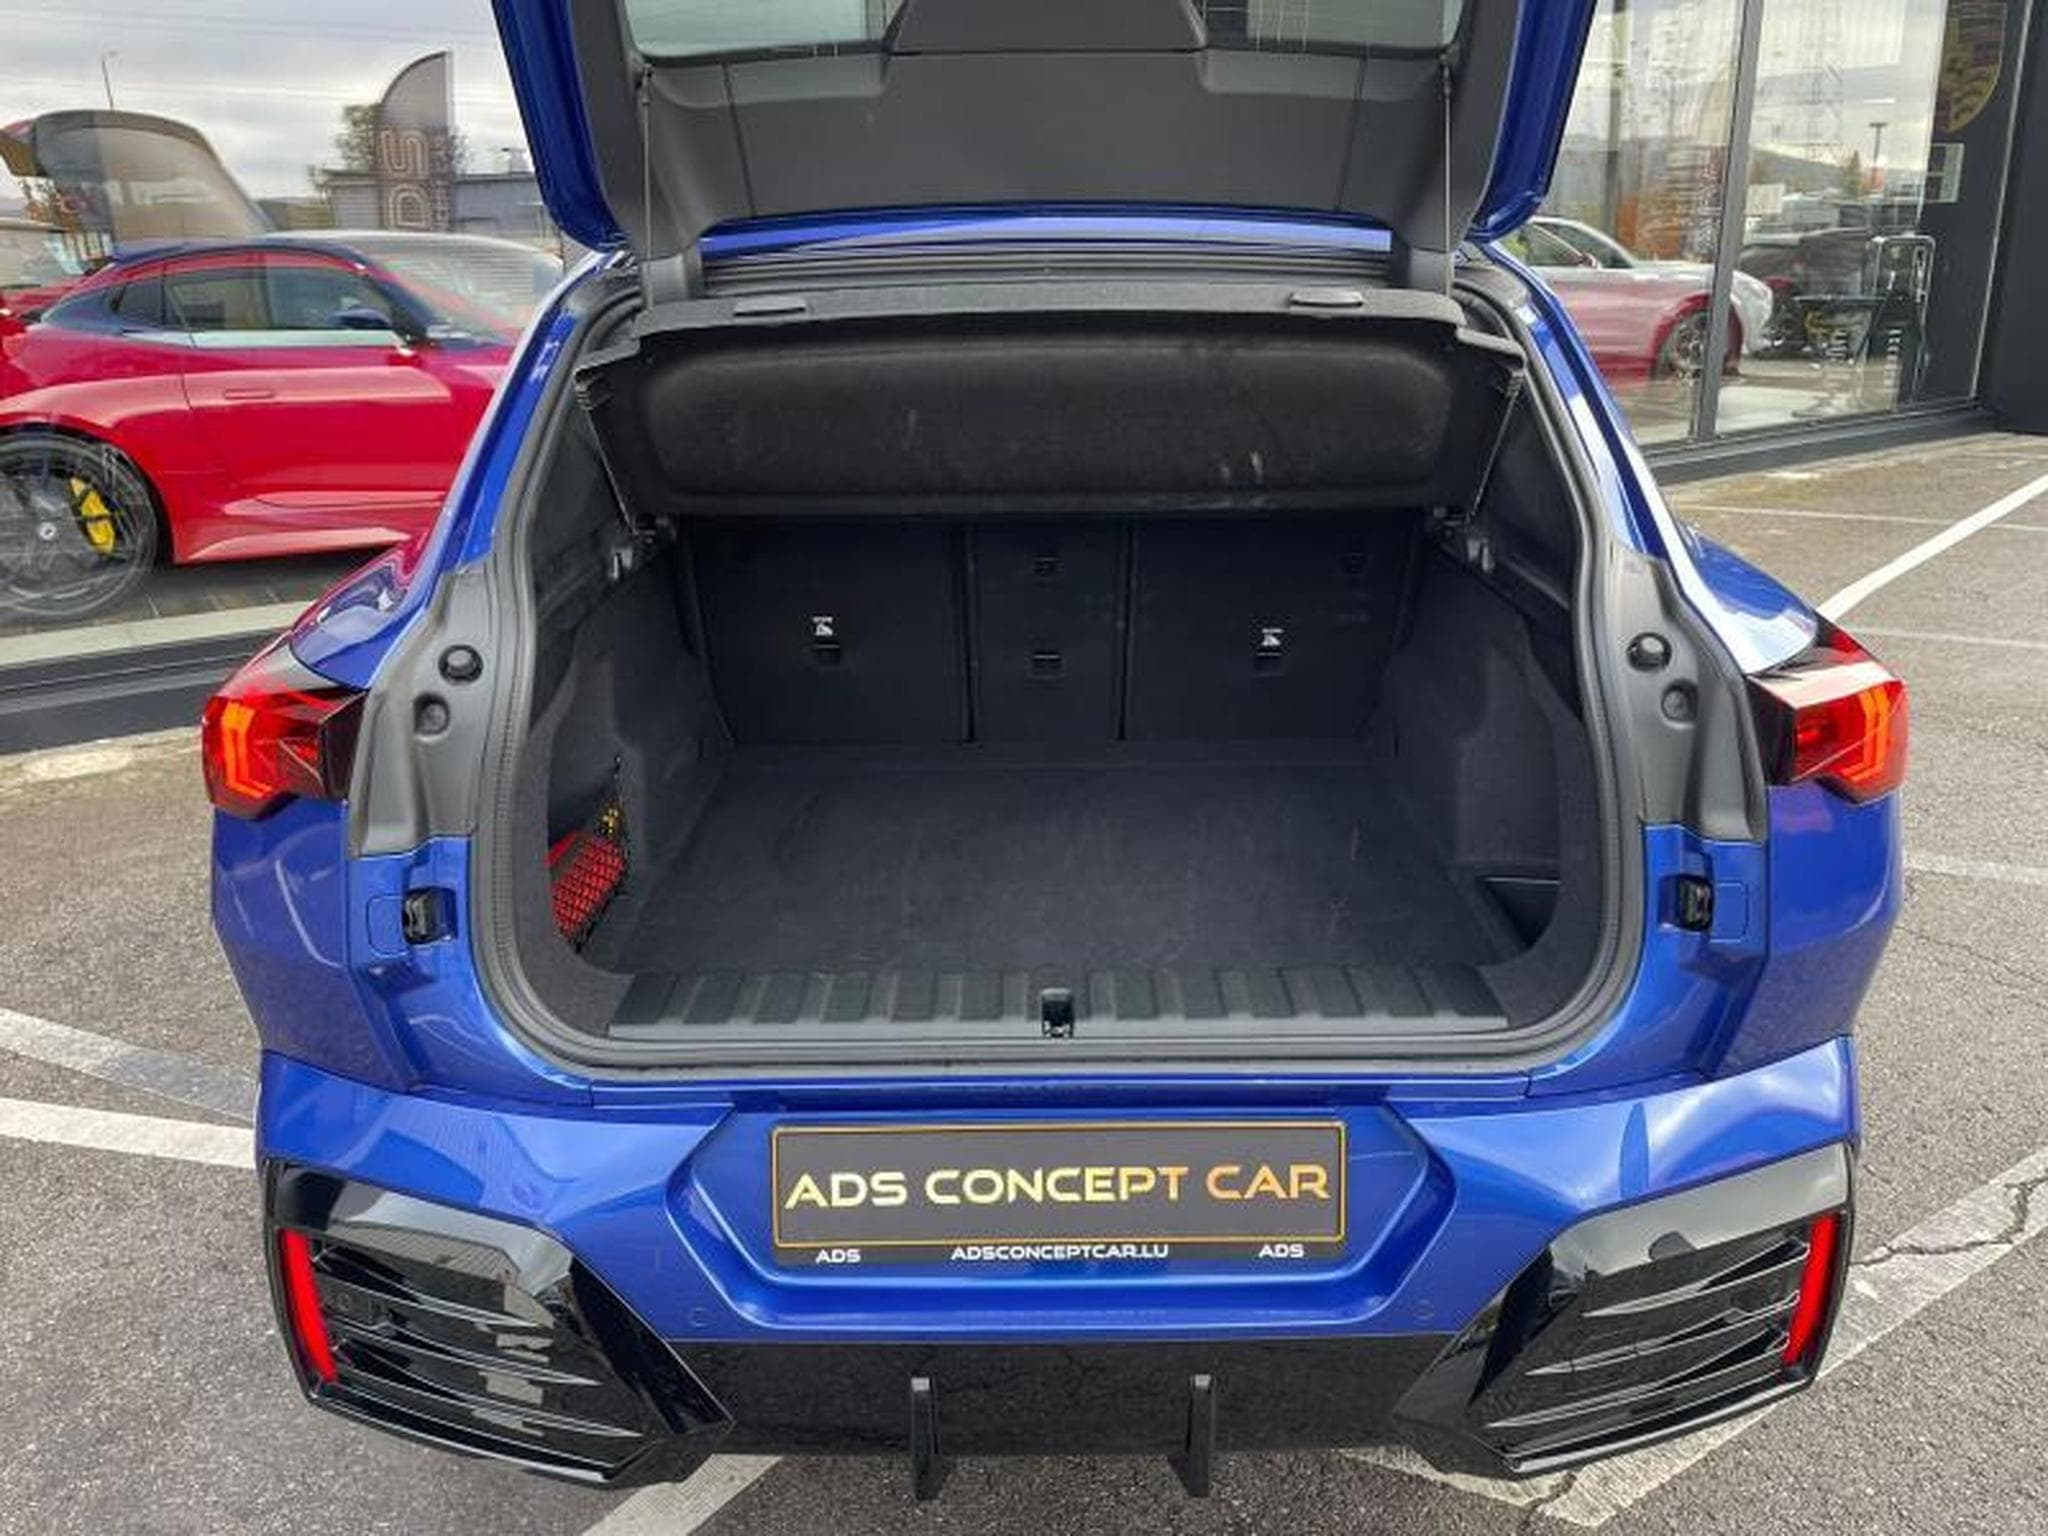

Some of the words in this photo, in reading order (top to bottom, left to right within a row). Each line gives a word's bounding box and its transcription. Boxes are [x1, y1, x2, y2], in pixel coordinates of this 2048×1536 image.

[784, 1173, 907, 1208] ADS
[925, 1166, 1188, 1205] CONCEPT
[1206, 1163, 1330, 1199] CAR
[815, 1248, 861, 1263] ADS
[951, 1244, 1169, 1261] ADSCONCEPTCAR.LU
[1258, 1243, 1304, 1258] ADS
